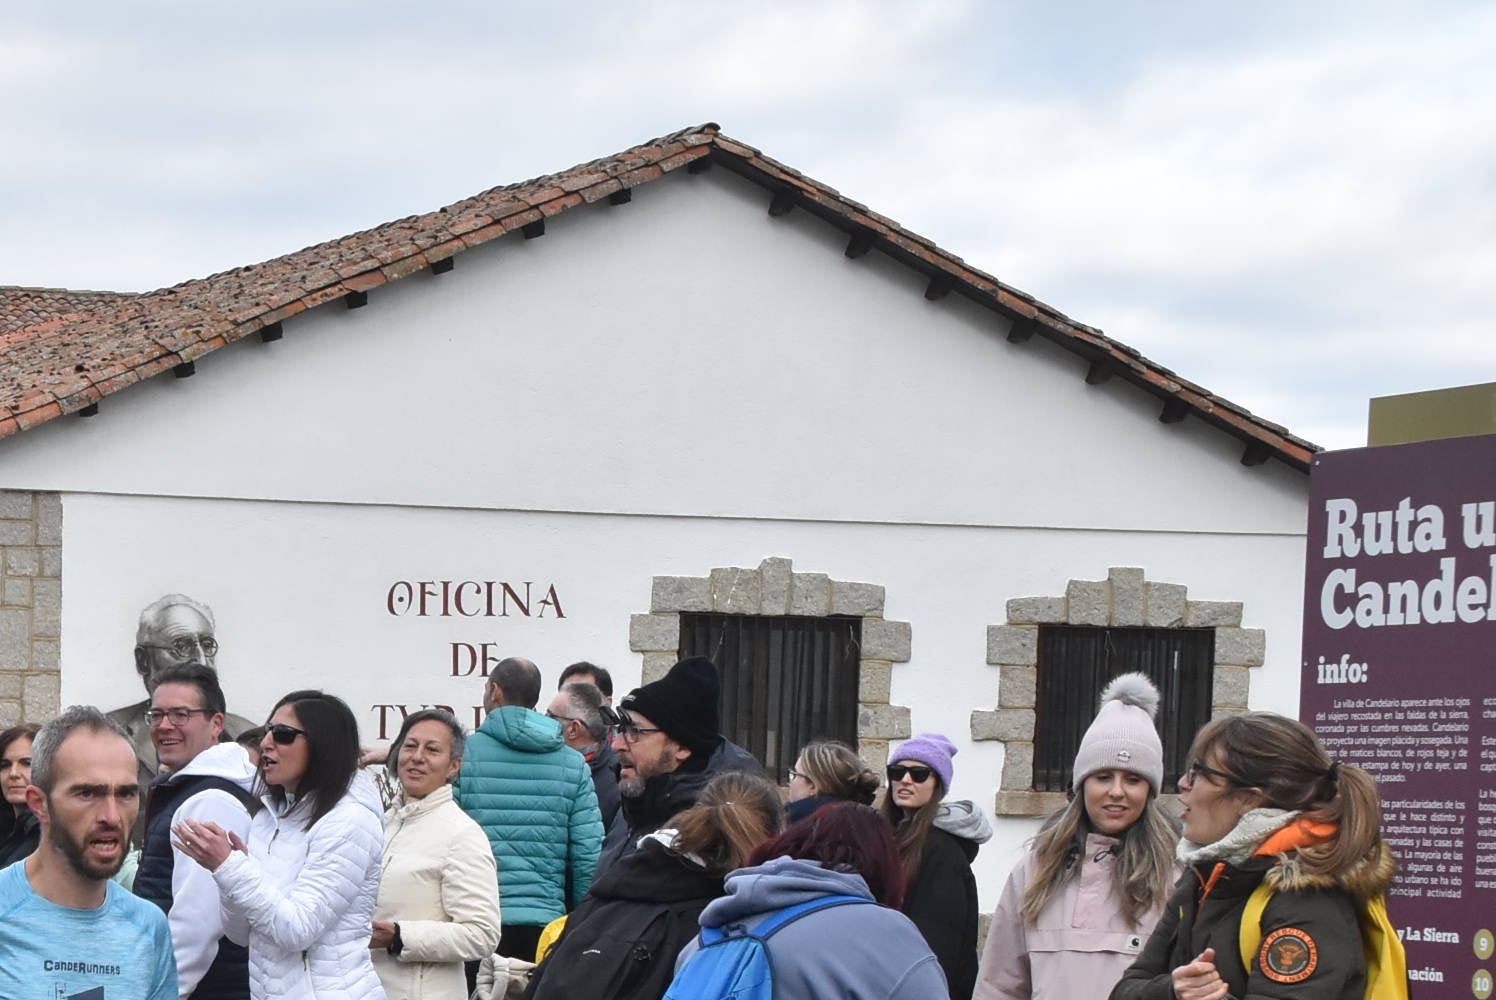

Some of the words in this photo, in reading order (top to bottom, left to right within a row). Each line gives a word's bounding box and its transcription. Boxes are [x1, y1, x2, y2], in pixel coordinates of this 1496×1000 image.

[1323, 498, 1446, 558] Ruta
[387, 580, 567, 619] OFICINA
[1317, 654, 1368, 684] info:
[1406, 927, 1421, 941] La
[1423, 927, 1459, 943] Sierra
[1479, 938, 1488, 951] 9
[1475, 977, 1489, 992] 10
